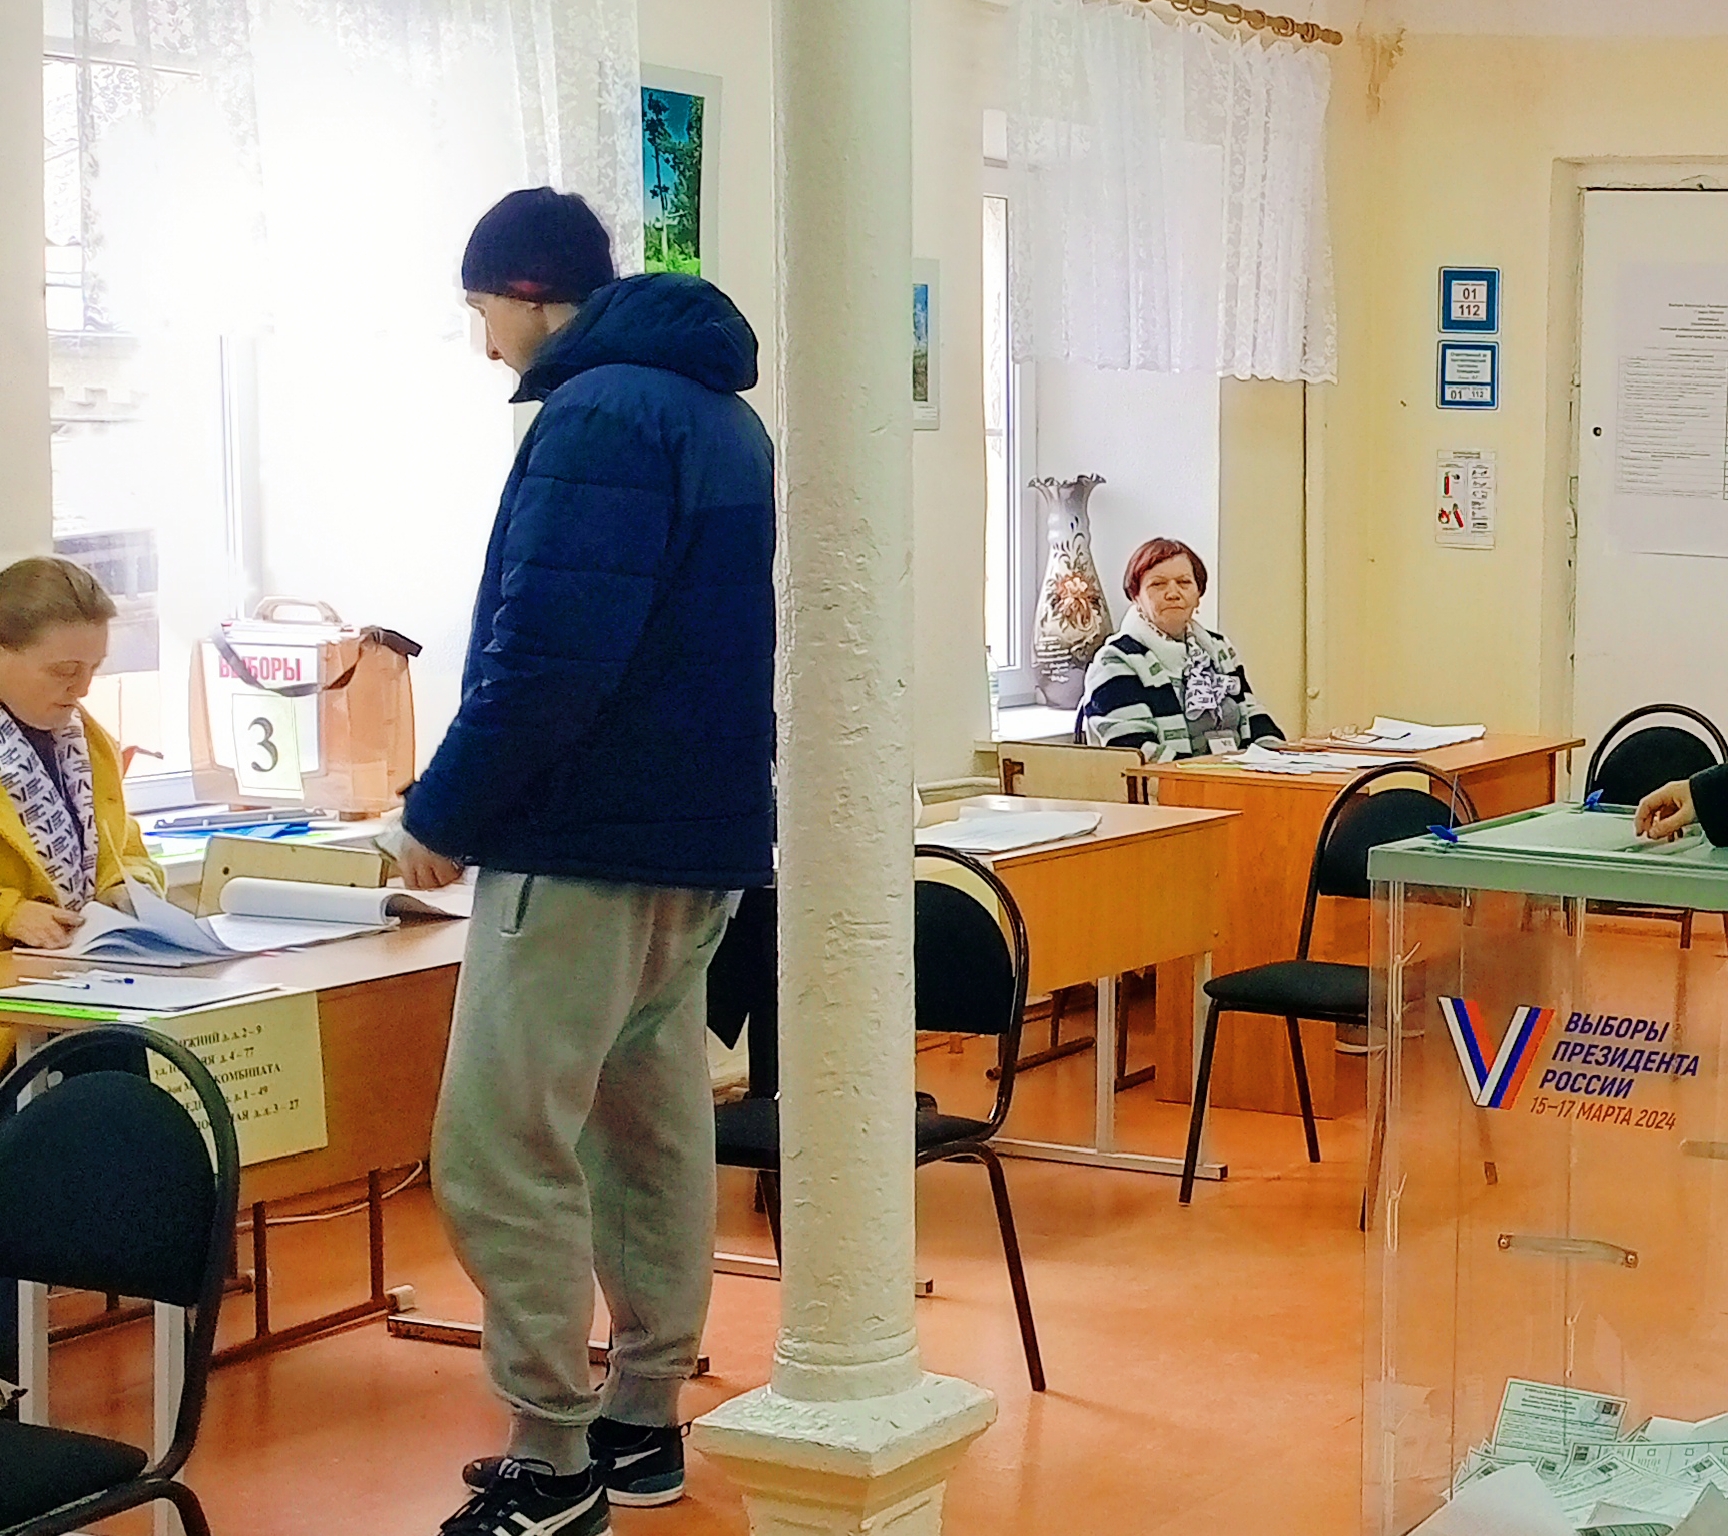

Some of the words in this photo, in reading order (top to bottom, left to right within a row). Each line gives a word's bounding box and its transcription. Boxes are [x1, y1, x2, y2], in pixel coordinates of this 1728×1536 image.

[1463, 287, 1477, 300] 01
[1458, 304, 1480, 316] 112
[248, 717, 278, 772] 3
[1564, 1012, 1670, 1042] ВЫБОРЫ
[1551, 1041, 1699, 1076] ПРЕЗИДЕНТА
[1539, 1069, 1635, 1099] РОССИИ
[1576, 1101, 1633, 1125] МАРТА
[1635, 1109, 1676, 1130] 2024
